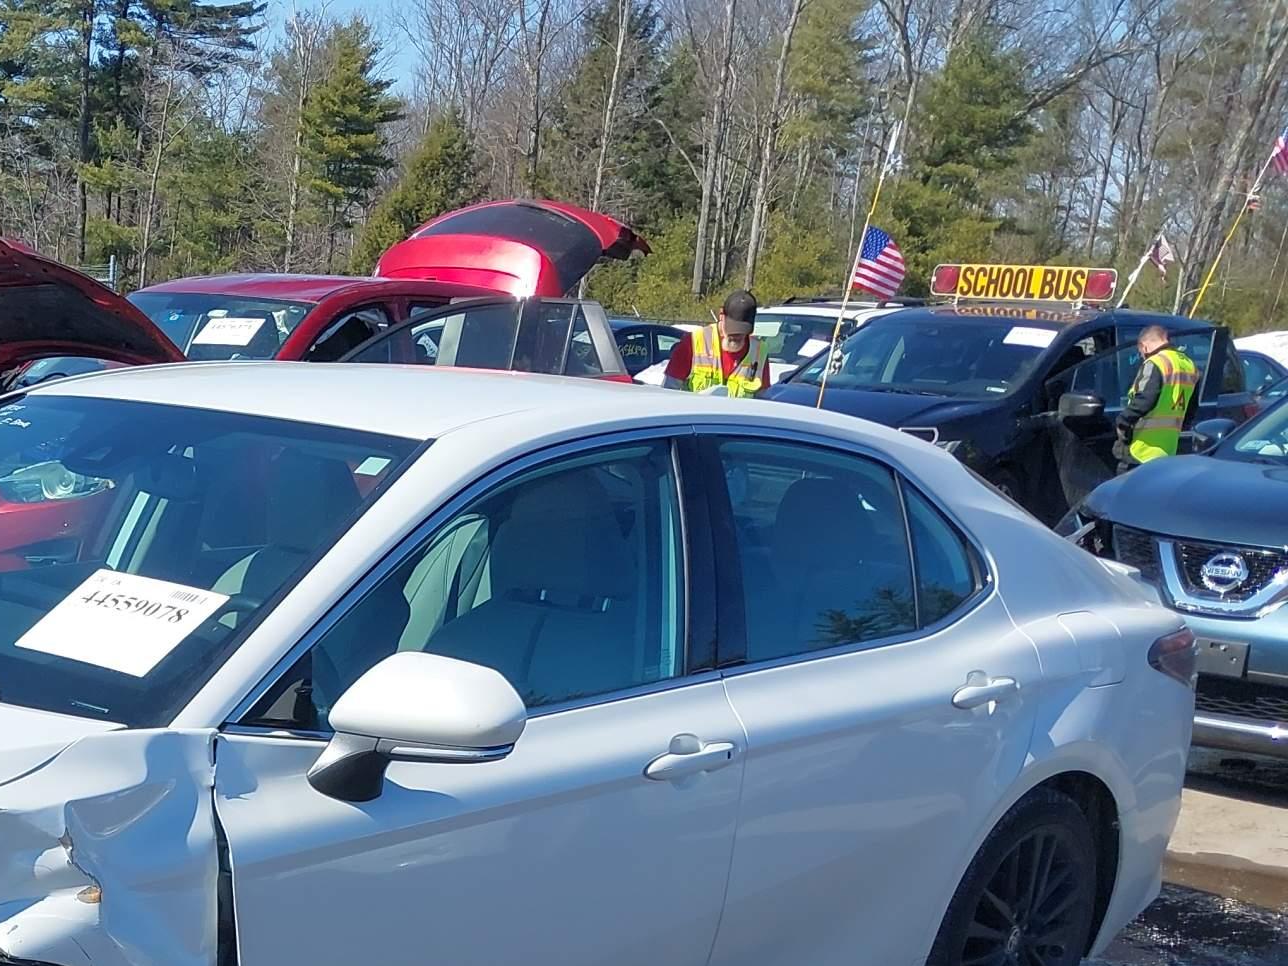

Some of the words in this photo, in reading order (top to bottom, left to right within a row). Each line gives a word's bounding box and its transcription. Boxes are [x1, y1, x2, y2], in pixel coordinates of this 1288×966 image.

[959, 266, 1034, 298] SCHOOL
[1038, 268, 1086, 300] BUS
[1206, 566, 1243, 577] NISSAN
[81, 590, 190, 624] 44559078
